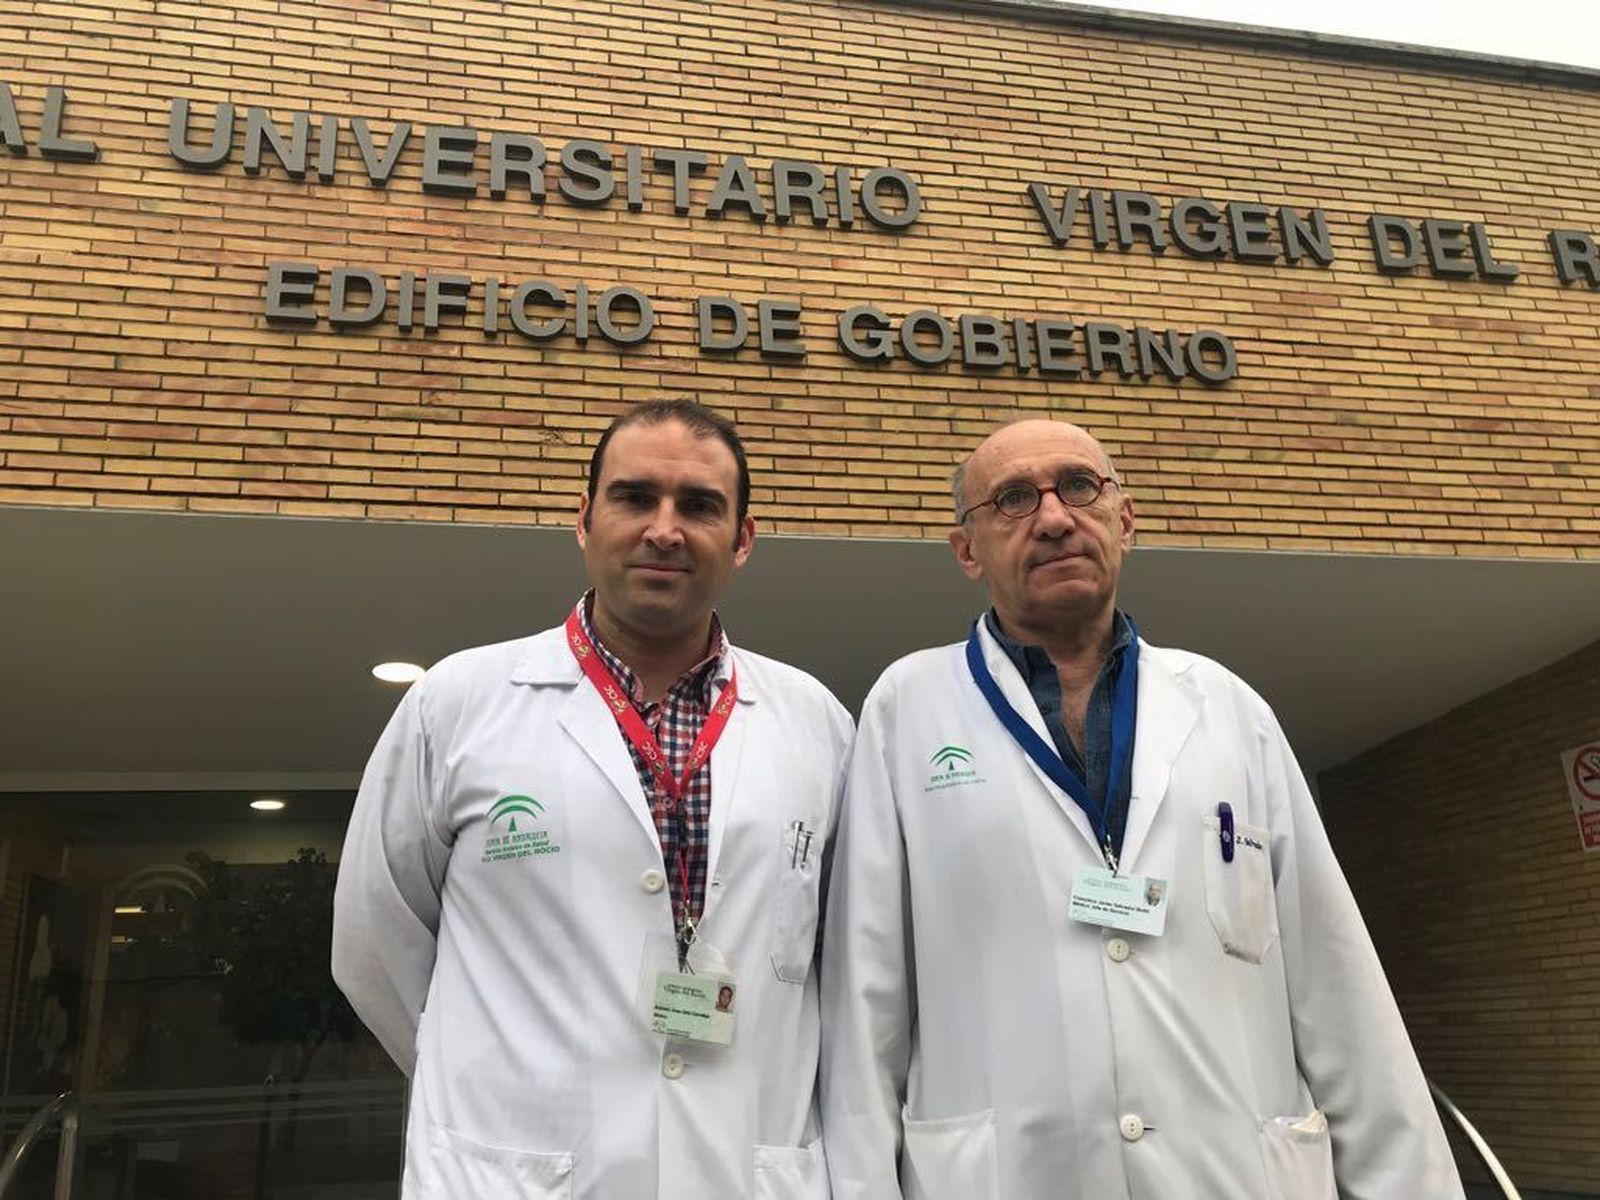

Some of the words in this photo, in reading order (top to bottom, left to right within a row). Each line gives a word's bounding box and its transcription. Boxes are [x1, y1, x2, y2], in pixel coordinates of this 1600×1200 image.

[167, 98, 921, 234] UNIVERSITARIO
[1027, 182, 1335, 267] VIRGEN
[1365, 212, 1520, 282] DEL
[265, 262, 655, 345] EDIFICIO
[699, 298, 805, 359] DE
[838, 305, 1239, 385] GOBIERNO
